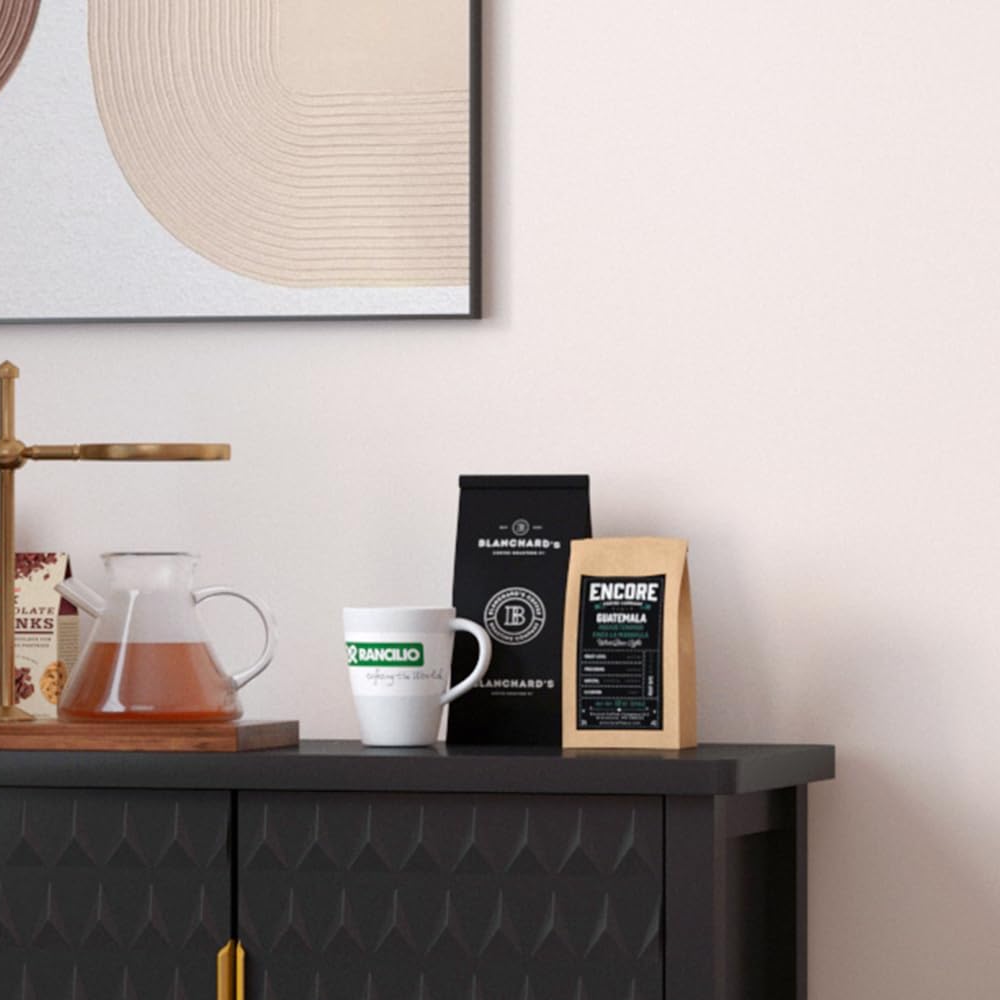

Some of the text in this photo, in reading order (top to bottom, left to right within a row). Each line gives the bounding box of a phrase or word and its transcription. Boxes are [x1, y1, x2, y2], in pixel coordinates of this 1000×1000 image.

[478, 538, 561, 549] BLANCHARD'S
[589, 582, 659, 602] ENCORE
[595, 612, 648, 623] GUATEMALA
[358, 647, 421, 662] RANCILIO
